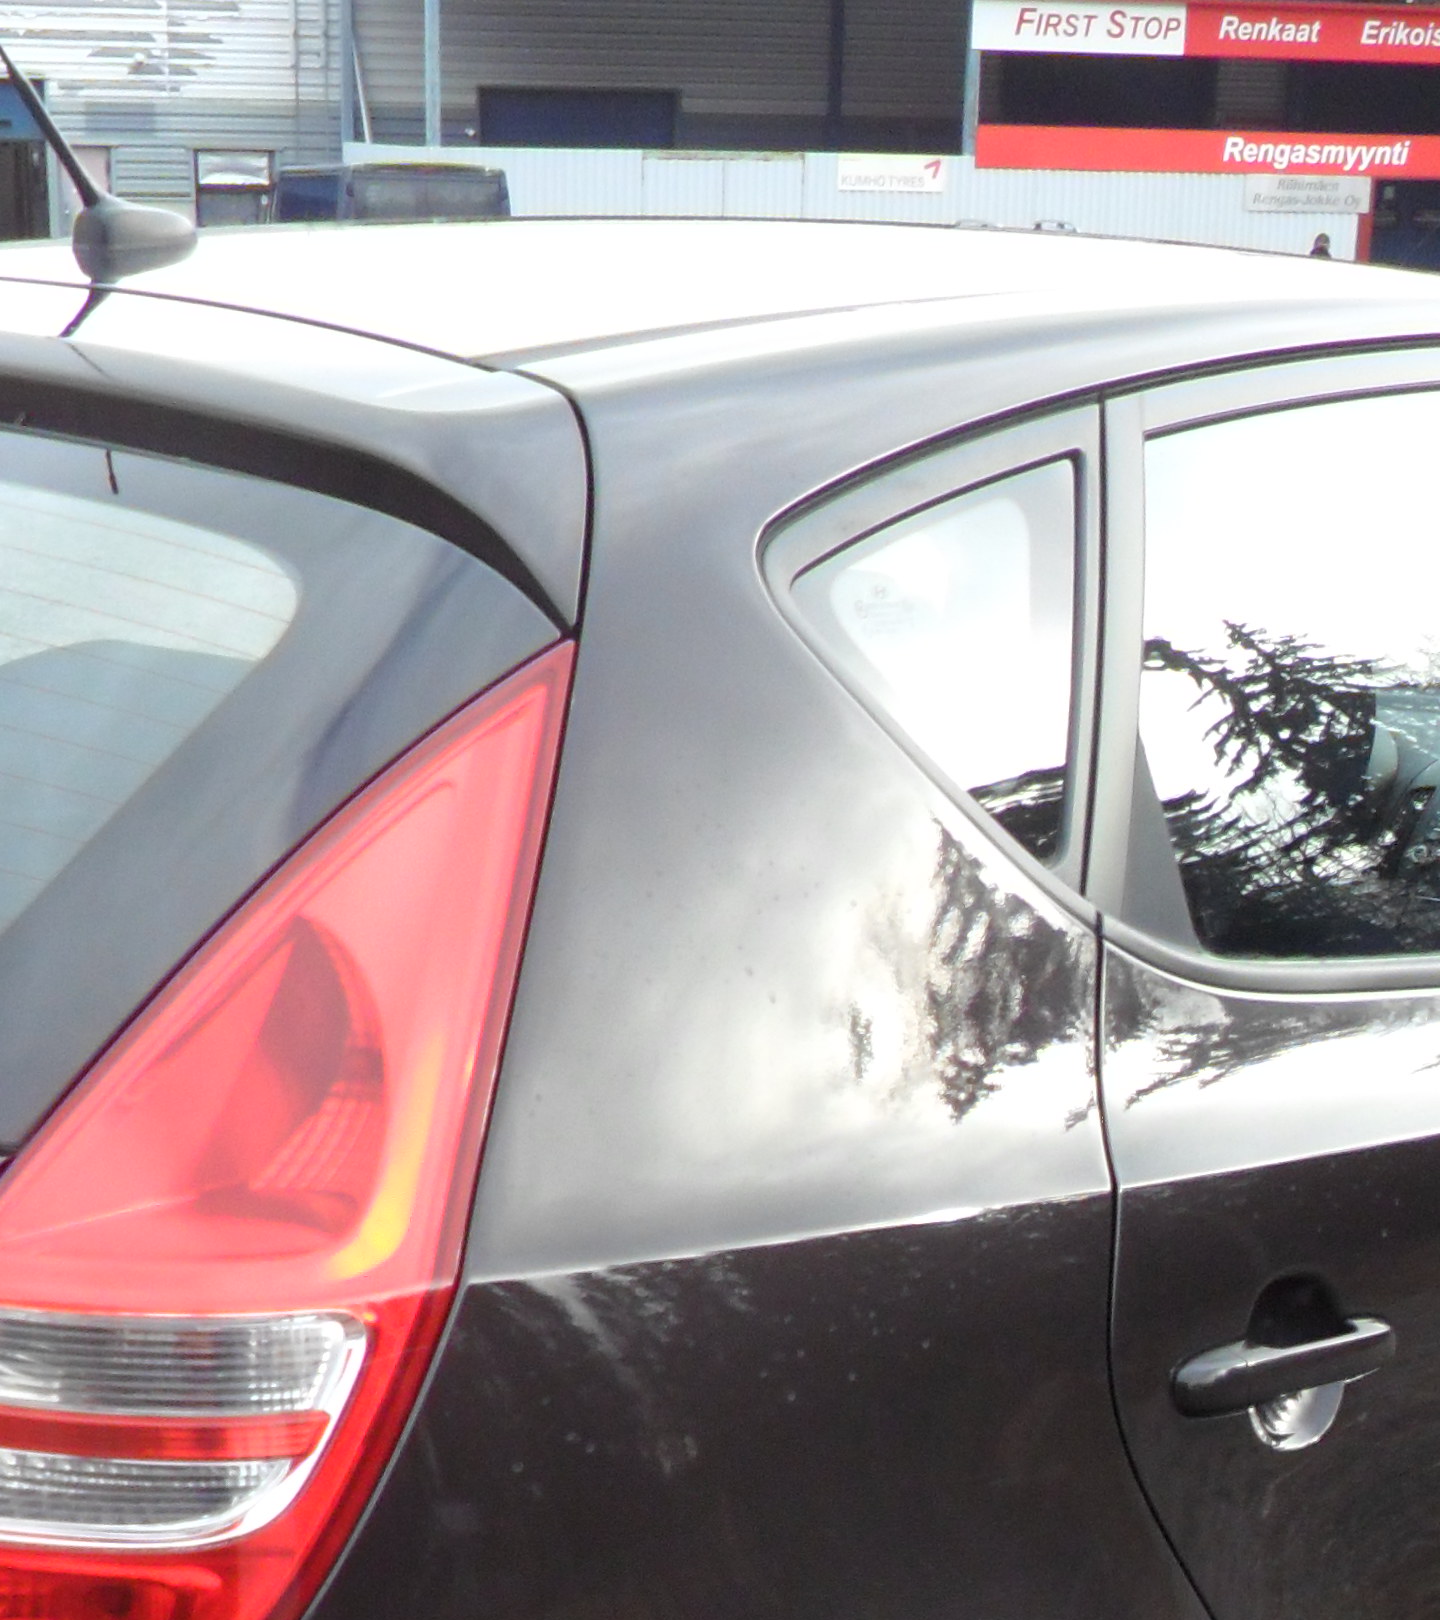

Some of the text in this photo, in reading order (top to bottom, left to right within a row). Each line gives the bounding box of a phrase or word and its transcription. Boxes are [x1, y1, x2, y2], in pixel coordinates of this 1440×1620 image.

[1015, 8, 1181, 40] FIRST STOP
[1219, 16, 1321, 43] Renkaat
[1222, 136, 1411, 171] Rengasmyynti
[841, 175, 926, 188] KUMHO TYRES
